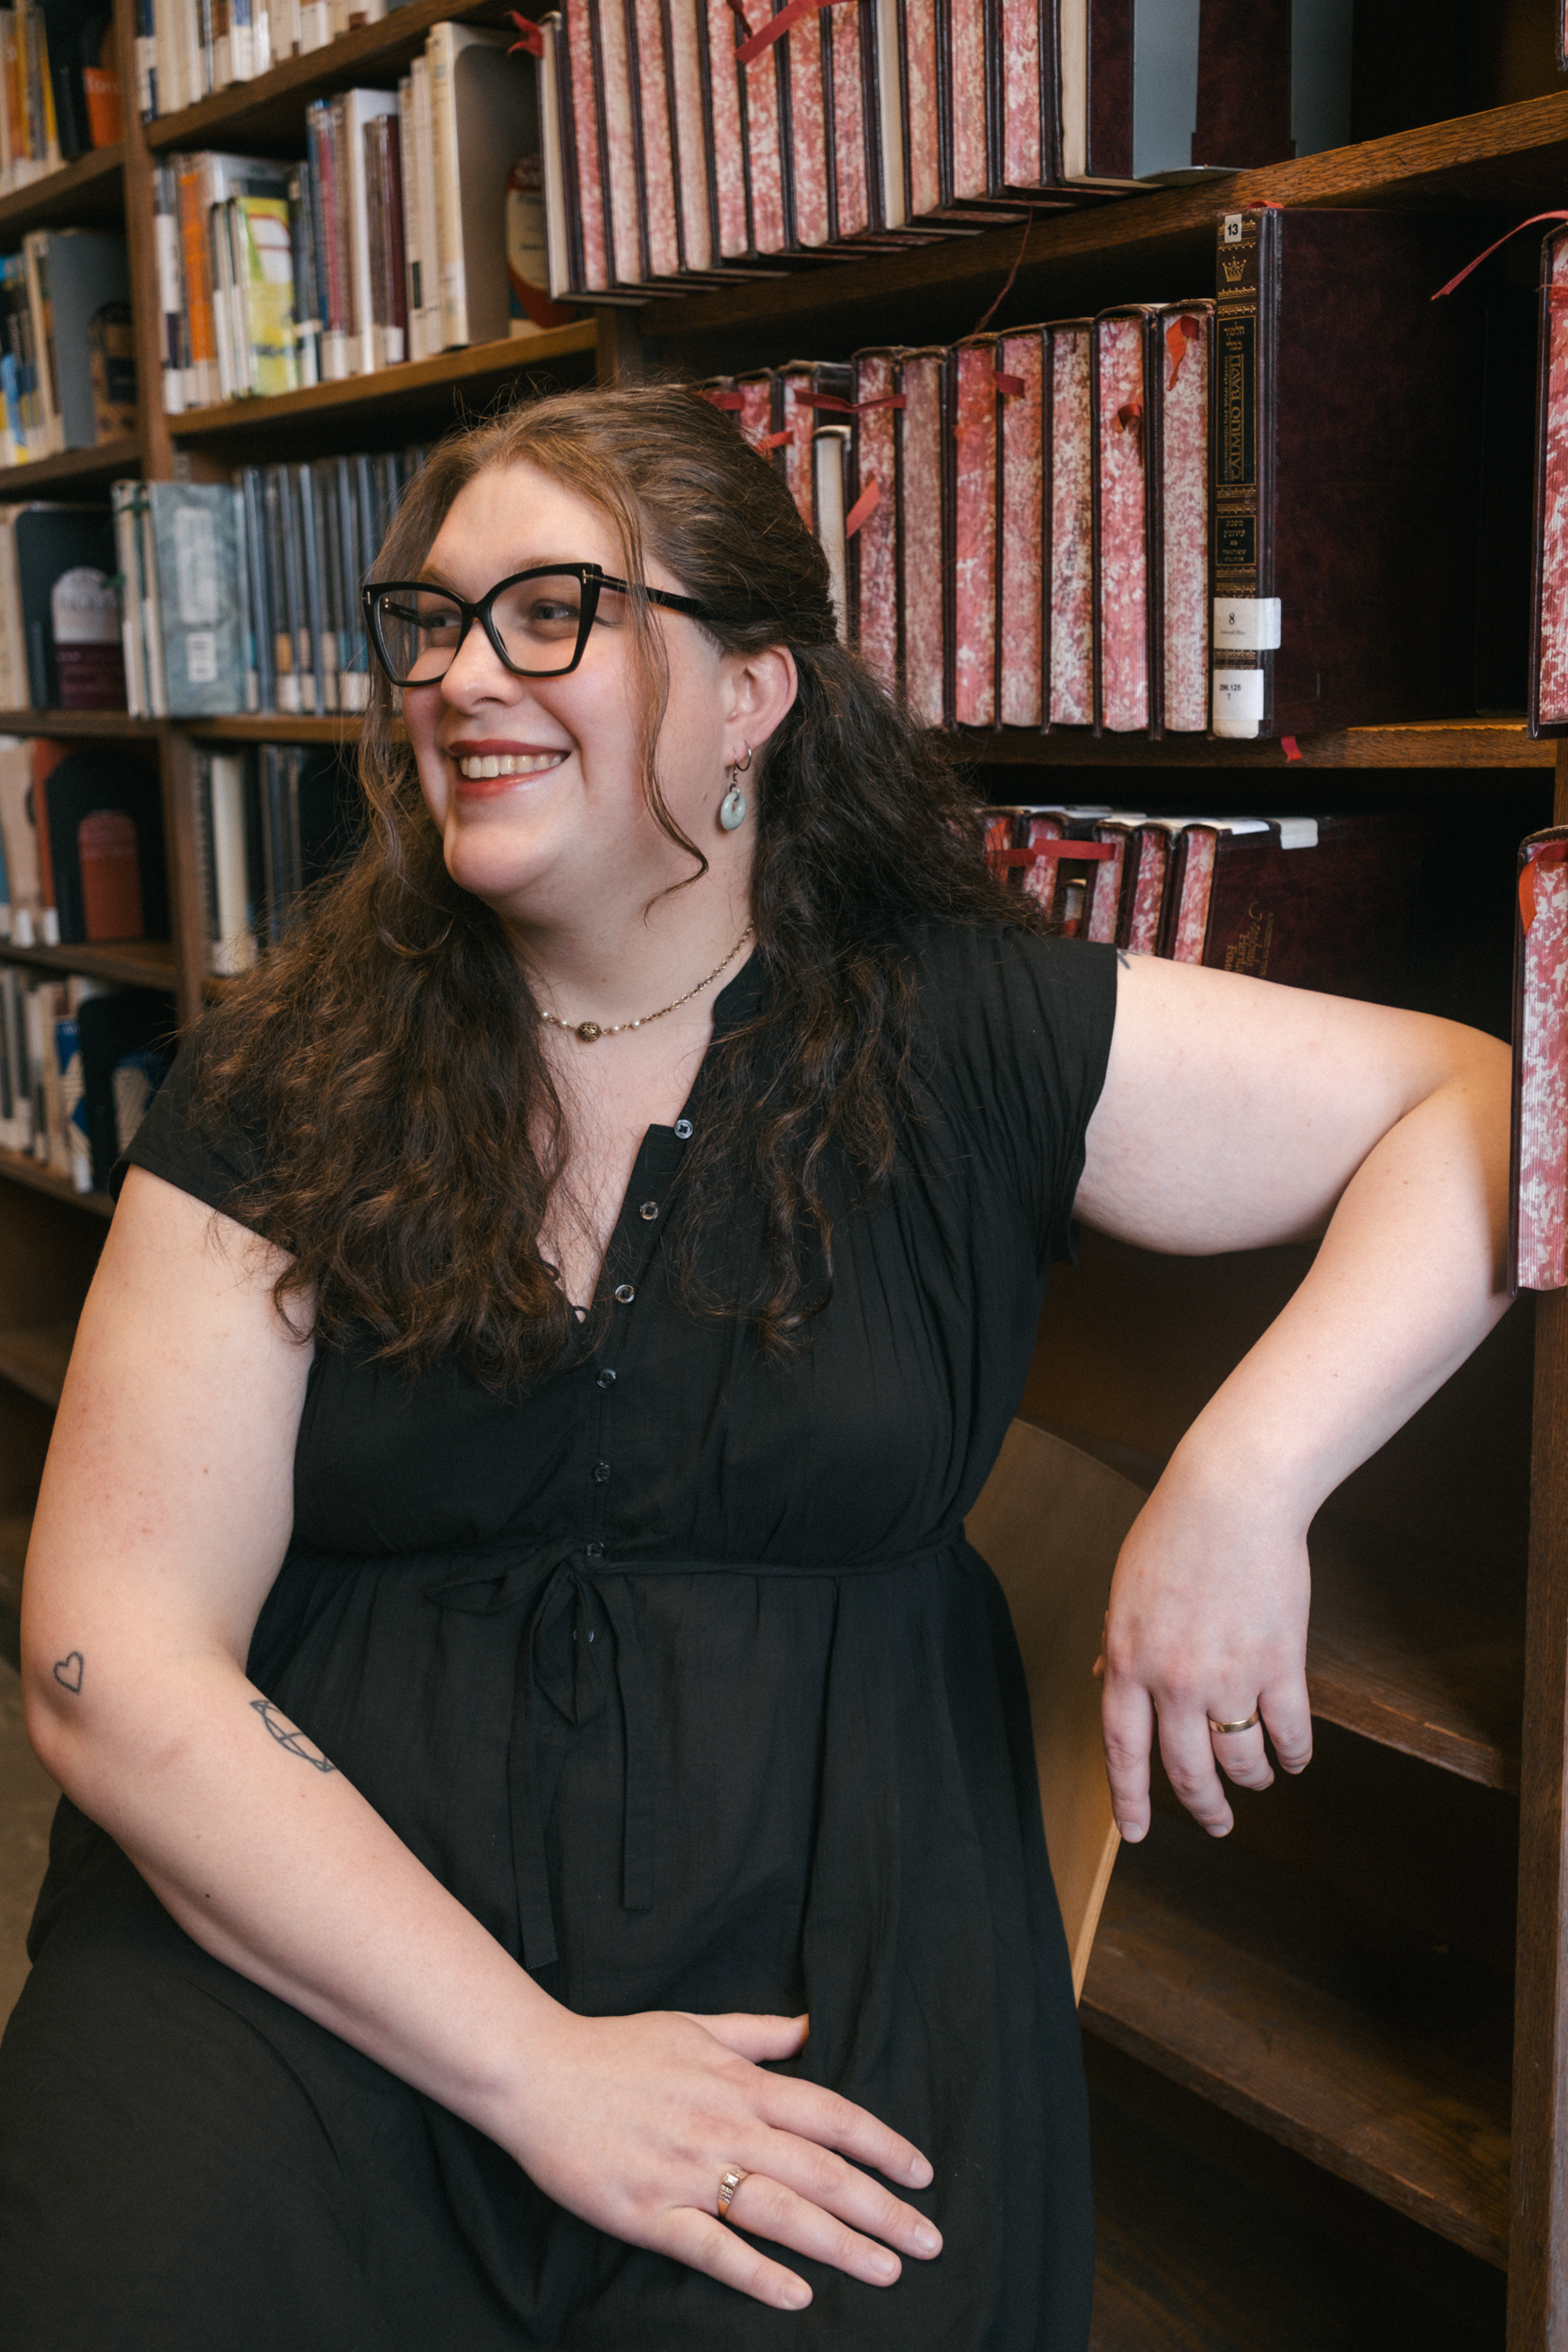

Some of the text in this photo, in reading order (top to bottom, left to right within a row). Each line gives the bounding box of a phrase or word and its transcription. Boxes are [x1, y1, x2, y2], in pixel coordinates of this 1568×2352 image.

[1227, 223, 1239, 236] 13
[1224, 321, 1245, 337] תלמוד
[1226, 337, 1243, 351] בבלי
[1230, 354, 1242, 481] TALMUD BAVLI
[1228, 612, 1235, 626] 8
[1219, 683, 1242, 691] 296.125
